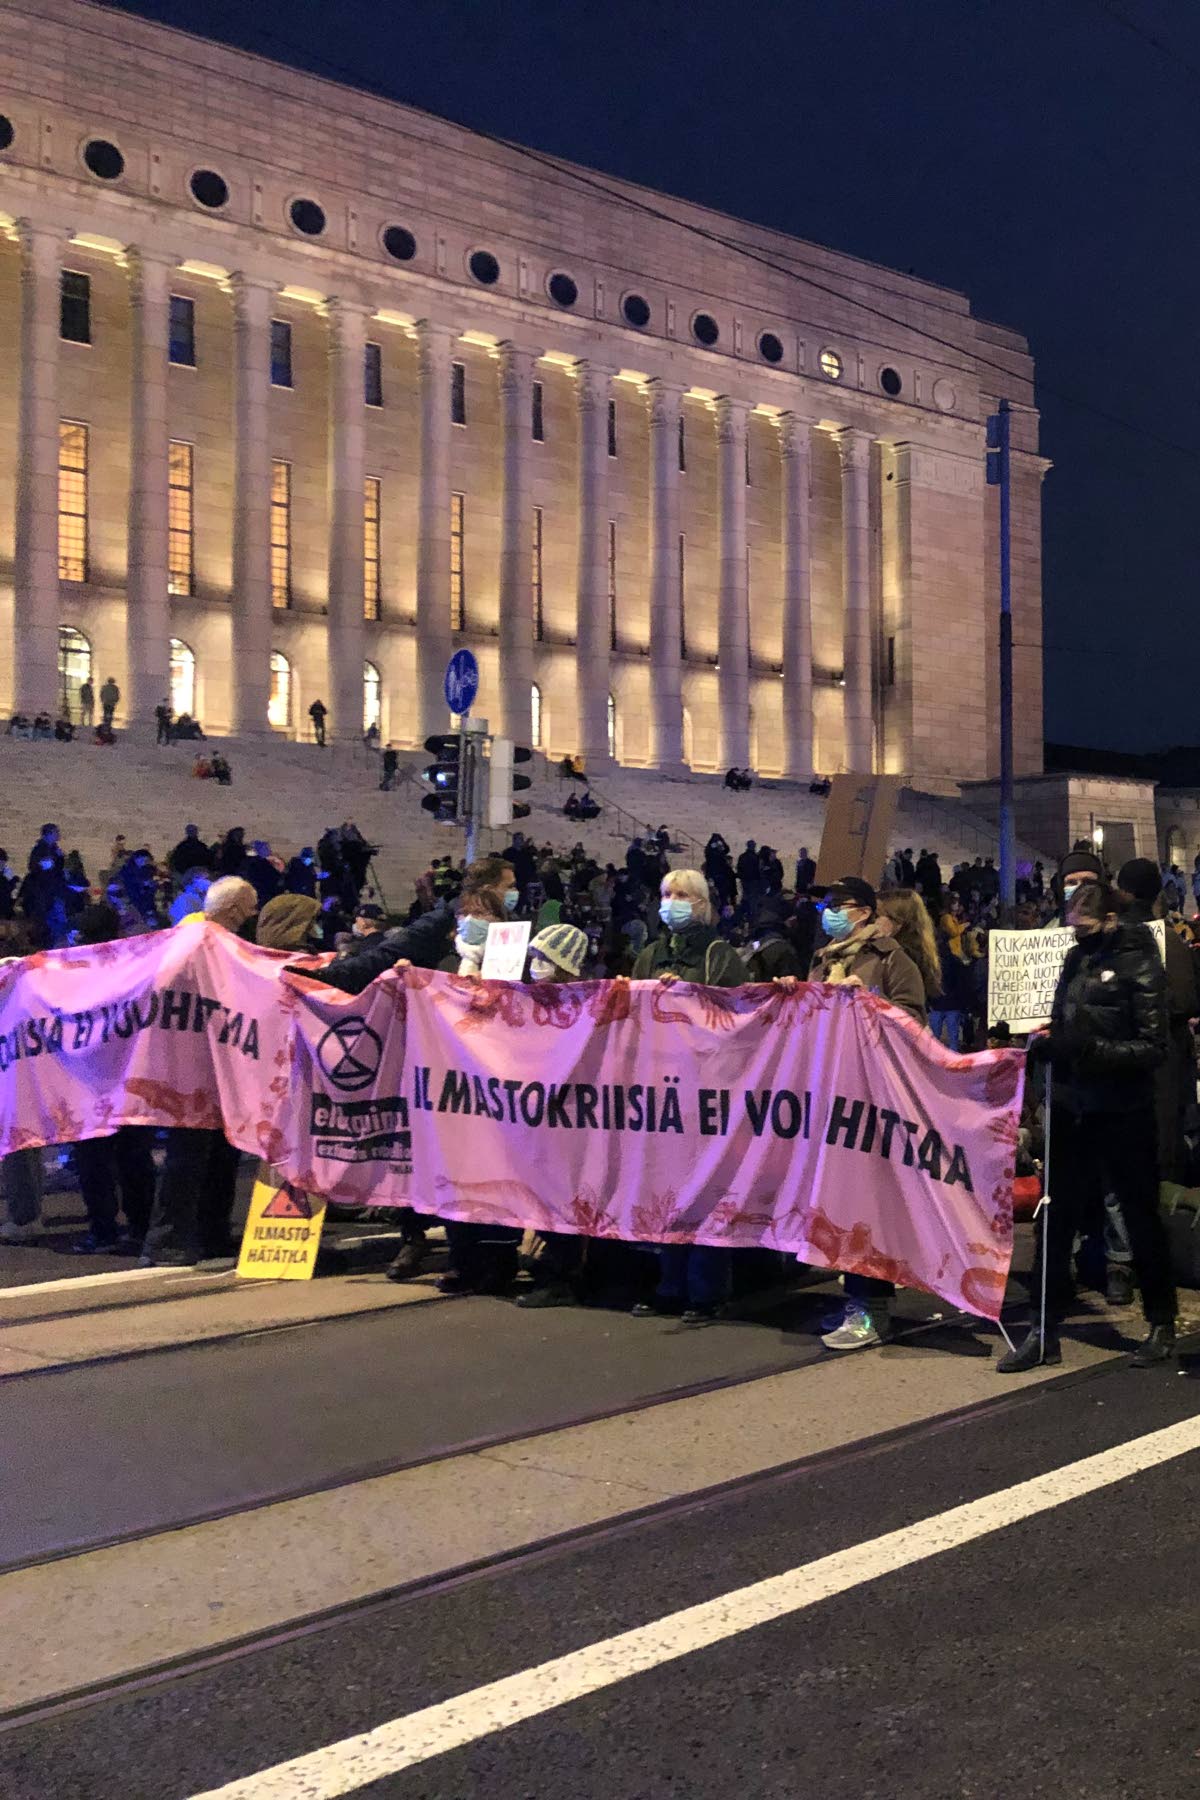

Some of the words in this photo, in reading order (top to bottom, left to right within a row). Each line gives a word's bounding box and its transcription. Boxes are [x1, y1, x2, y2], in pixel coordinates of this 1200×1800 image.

[994, 935, 1040, 953] KUKAAN
[994, 954, 1019, 968] KUIN
[1022, 951, 1053, 967] KAIKKI
[994, 969, 1030, 982] VOIDA
[414, 1066, 684, 1134] ILMASTOKRIISIÄ
[698, 1088, 730, 1136] EI
[744, 1089, 812, 1139] VOI
